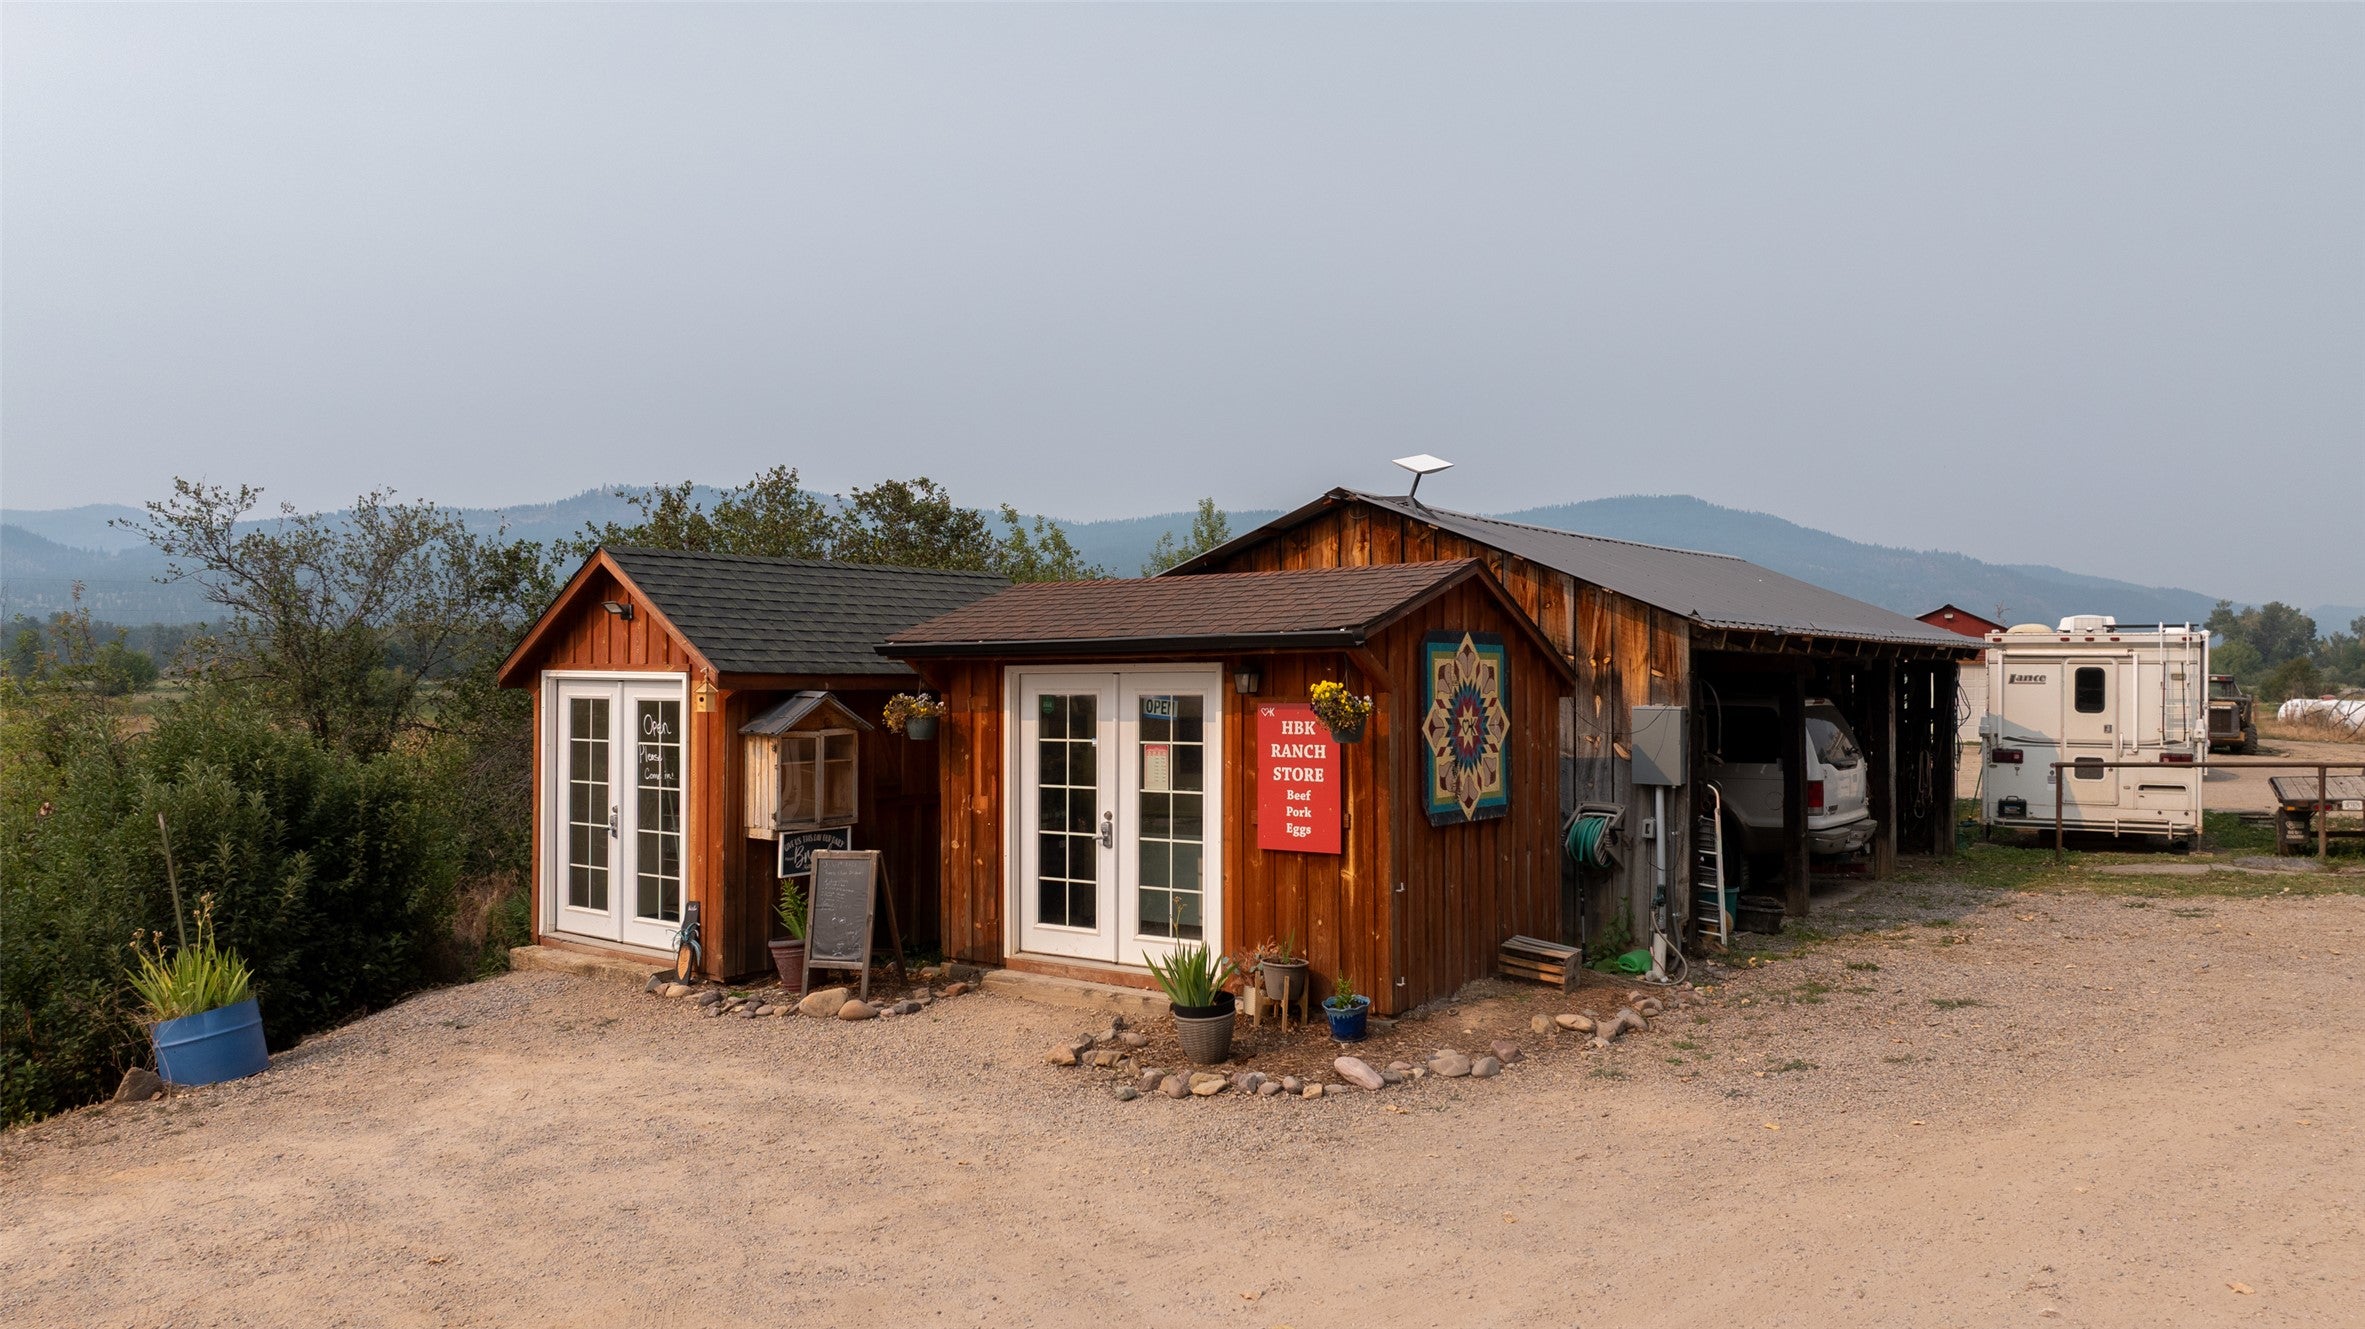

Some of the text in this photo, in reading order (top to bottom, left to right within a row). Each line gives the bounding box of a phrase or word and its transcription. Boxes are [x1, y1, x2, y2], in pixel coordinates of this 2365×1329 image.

[2008, 674, 2047, 685] Lance
[1146, 699, 1175, 717] OPEN
[643, 714, 672, 736] Open
[1281, 720, 1316, 735] HBK
[639, 744, 663, 763] Please
[1271, 744, 1327, 759] RANCH
[1273, 767, 1325, 782] STORE
[1287, 790, 1312, 801] Beef
[1286, 806, 1312, 818] Pork
[1286, 823, 1312, 838] Eggs
